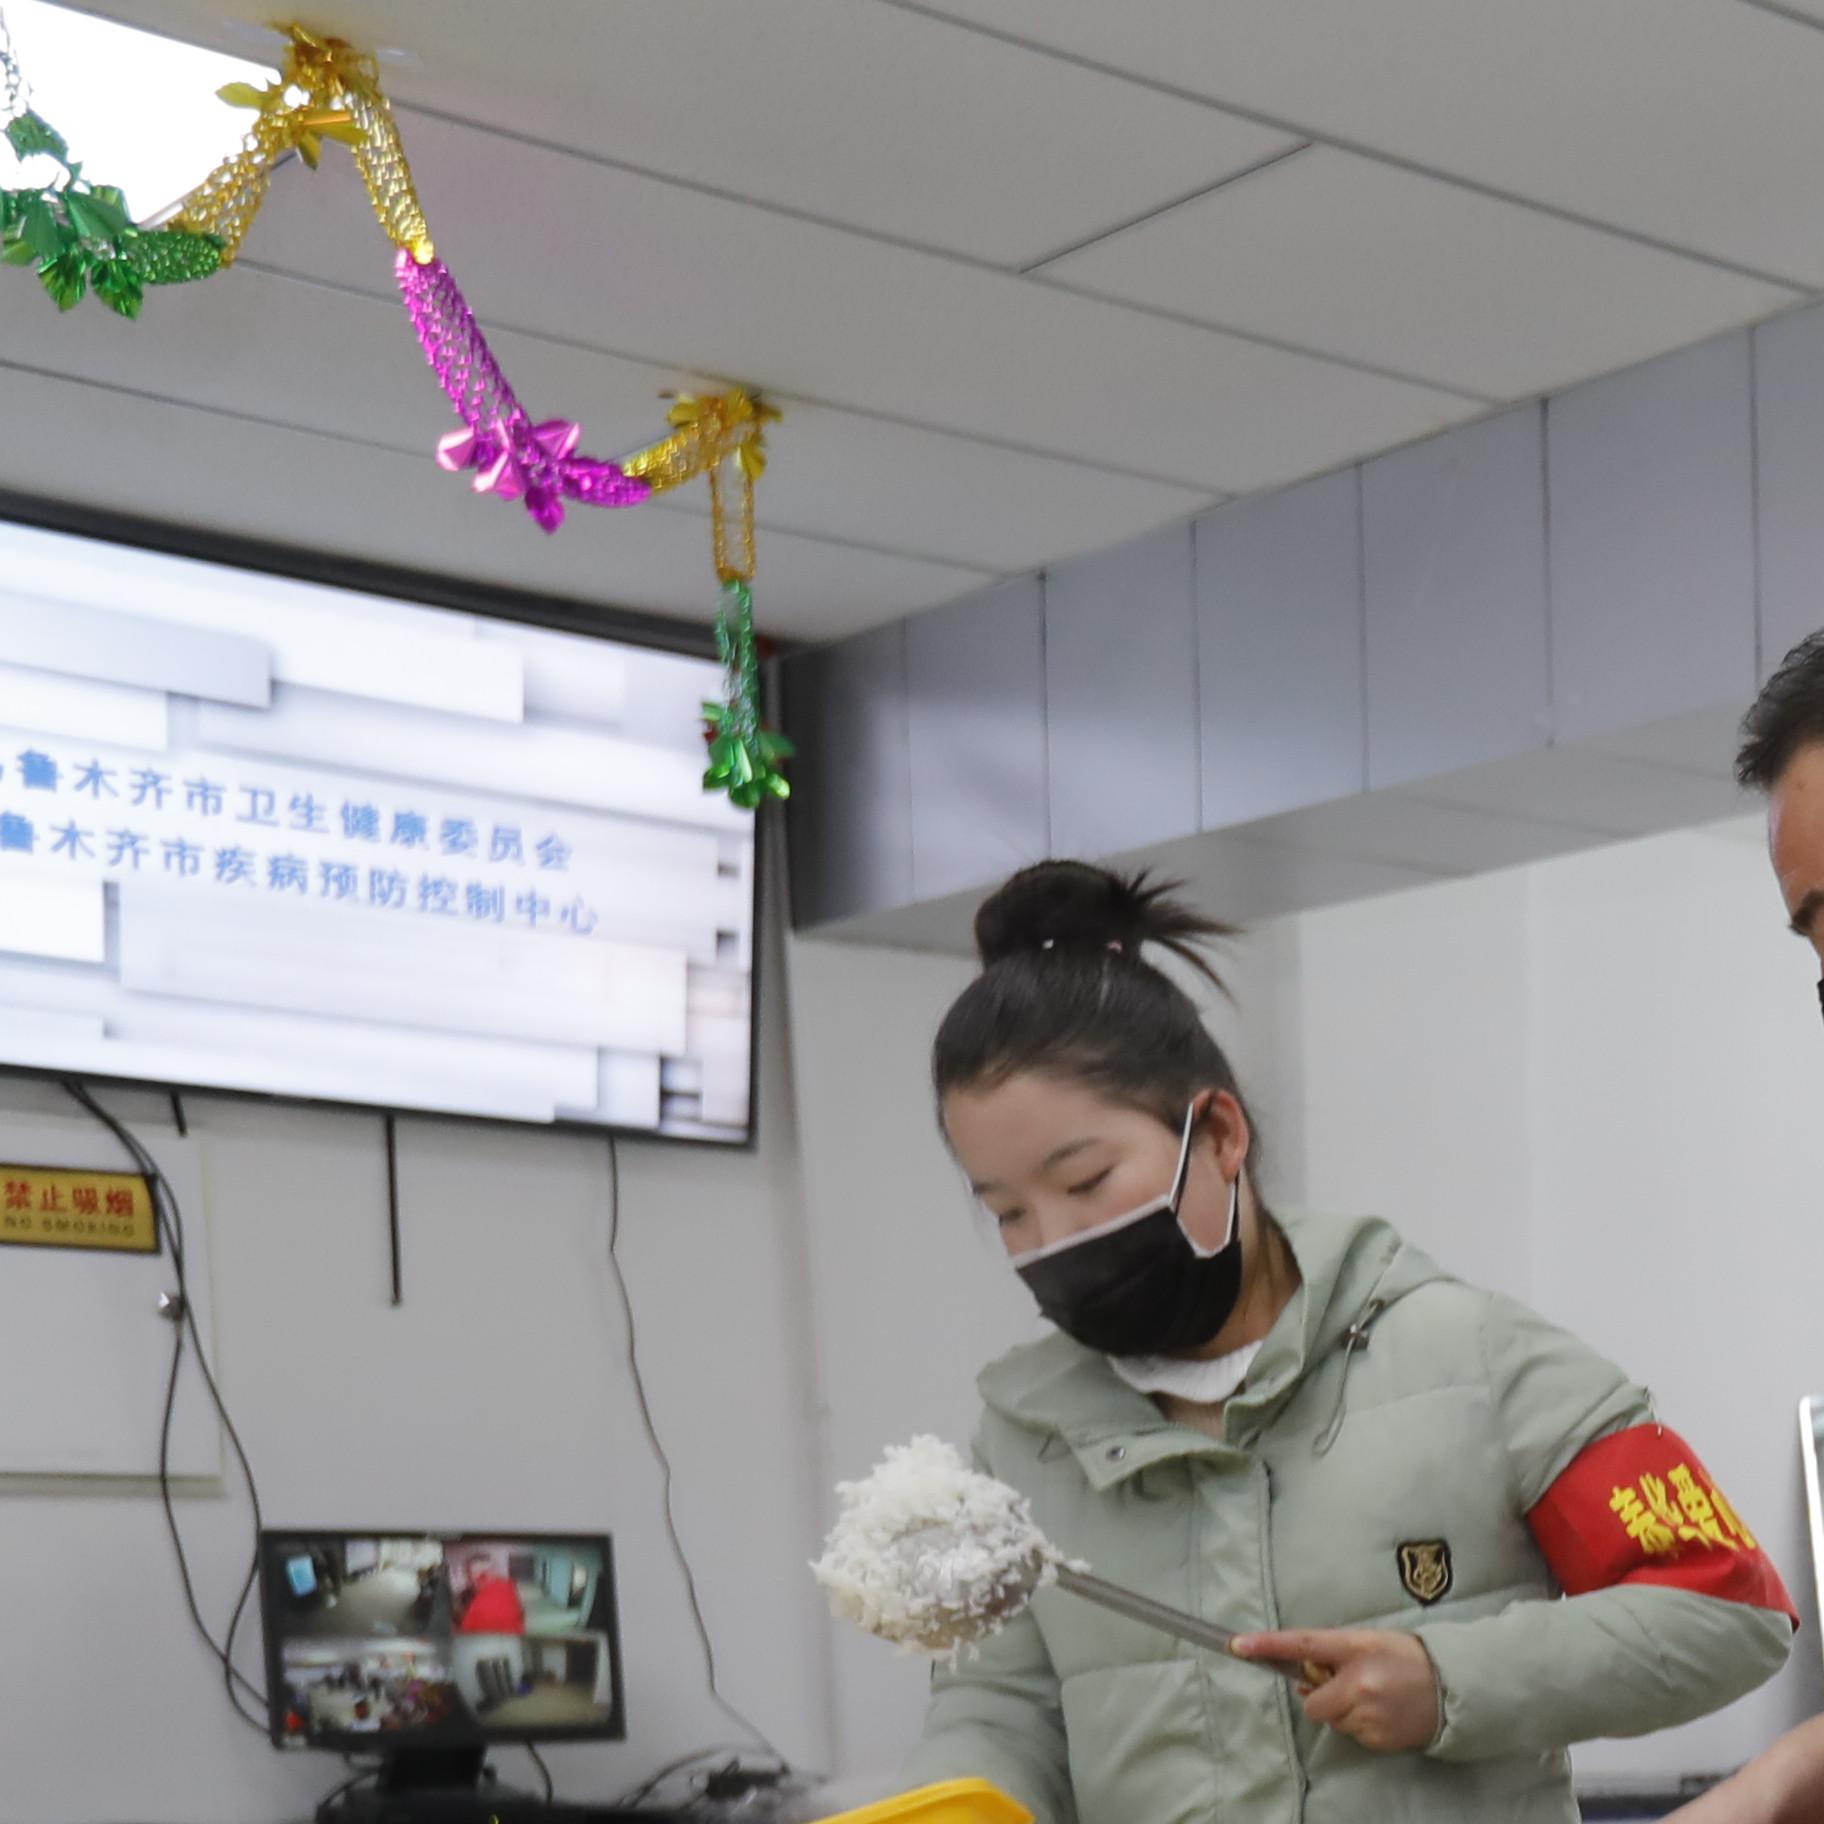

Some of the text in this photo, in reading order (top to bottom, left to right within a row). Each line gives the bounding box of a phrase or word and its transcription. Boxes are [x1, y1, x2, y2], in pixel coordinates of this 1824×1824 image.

[0, 748, 572, 870] 鲁木齐市卫生健康委员会
[5, 1180, 134, 1217] 禁止吸烟
